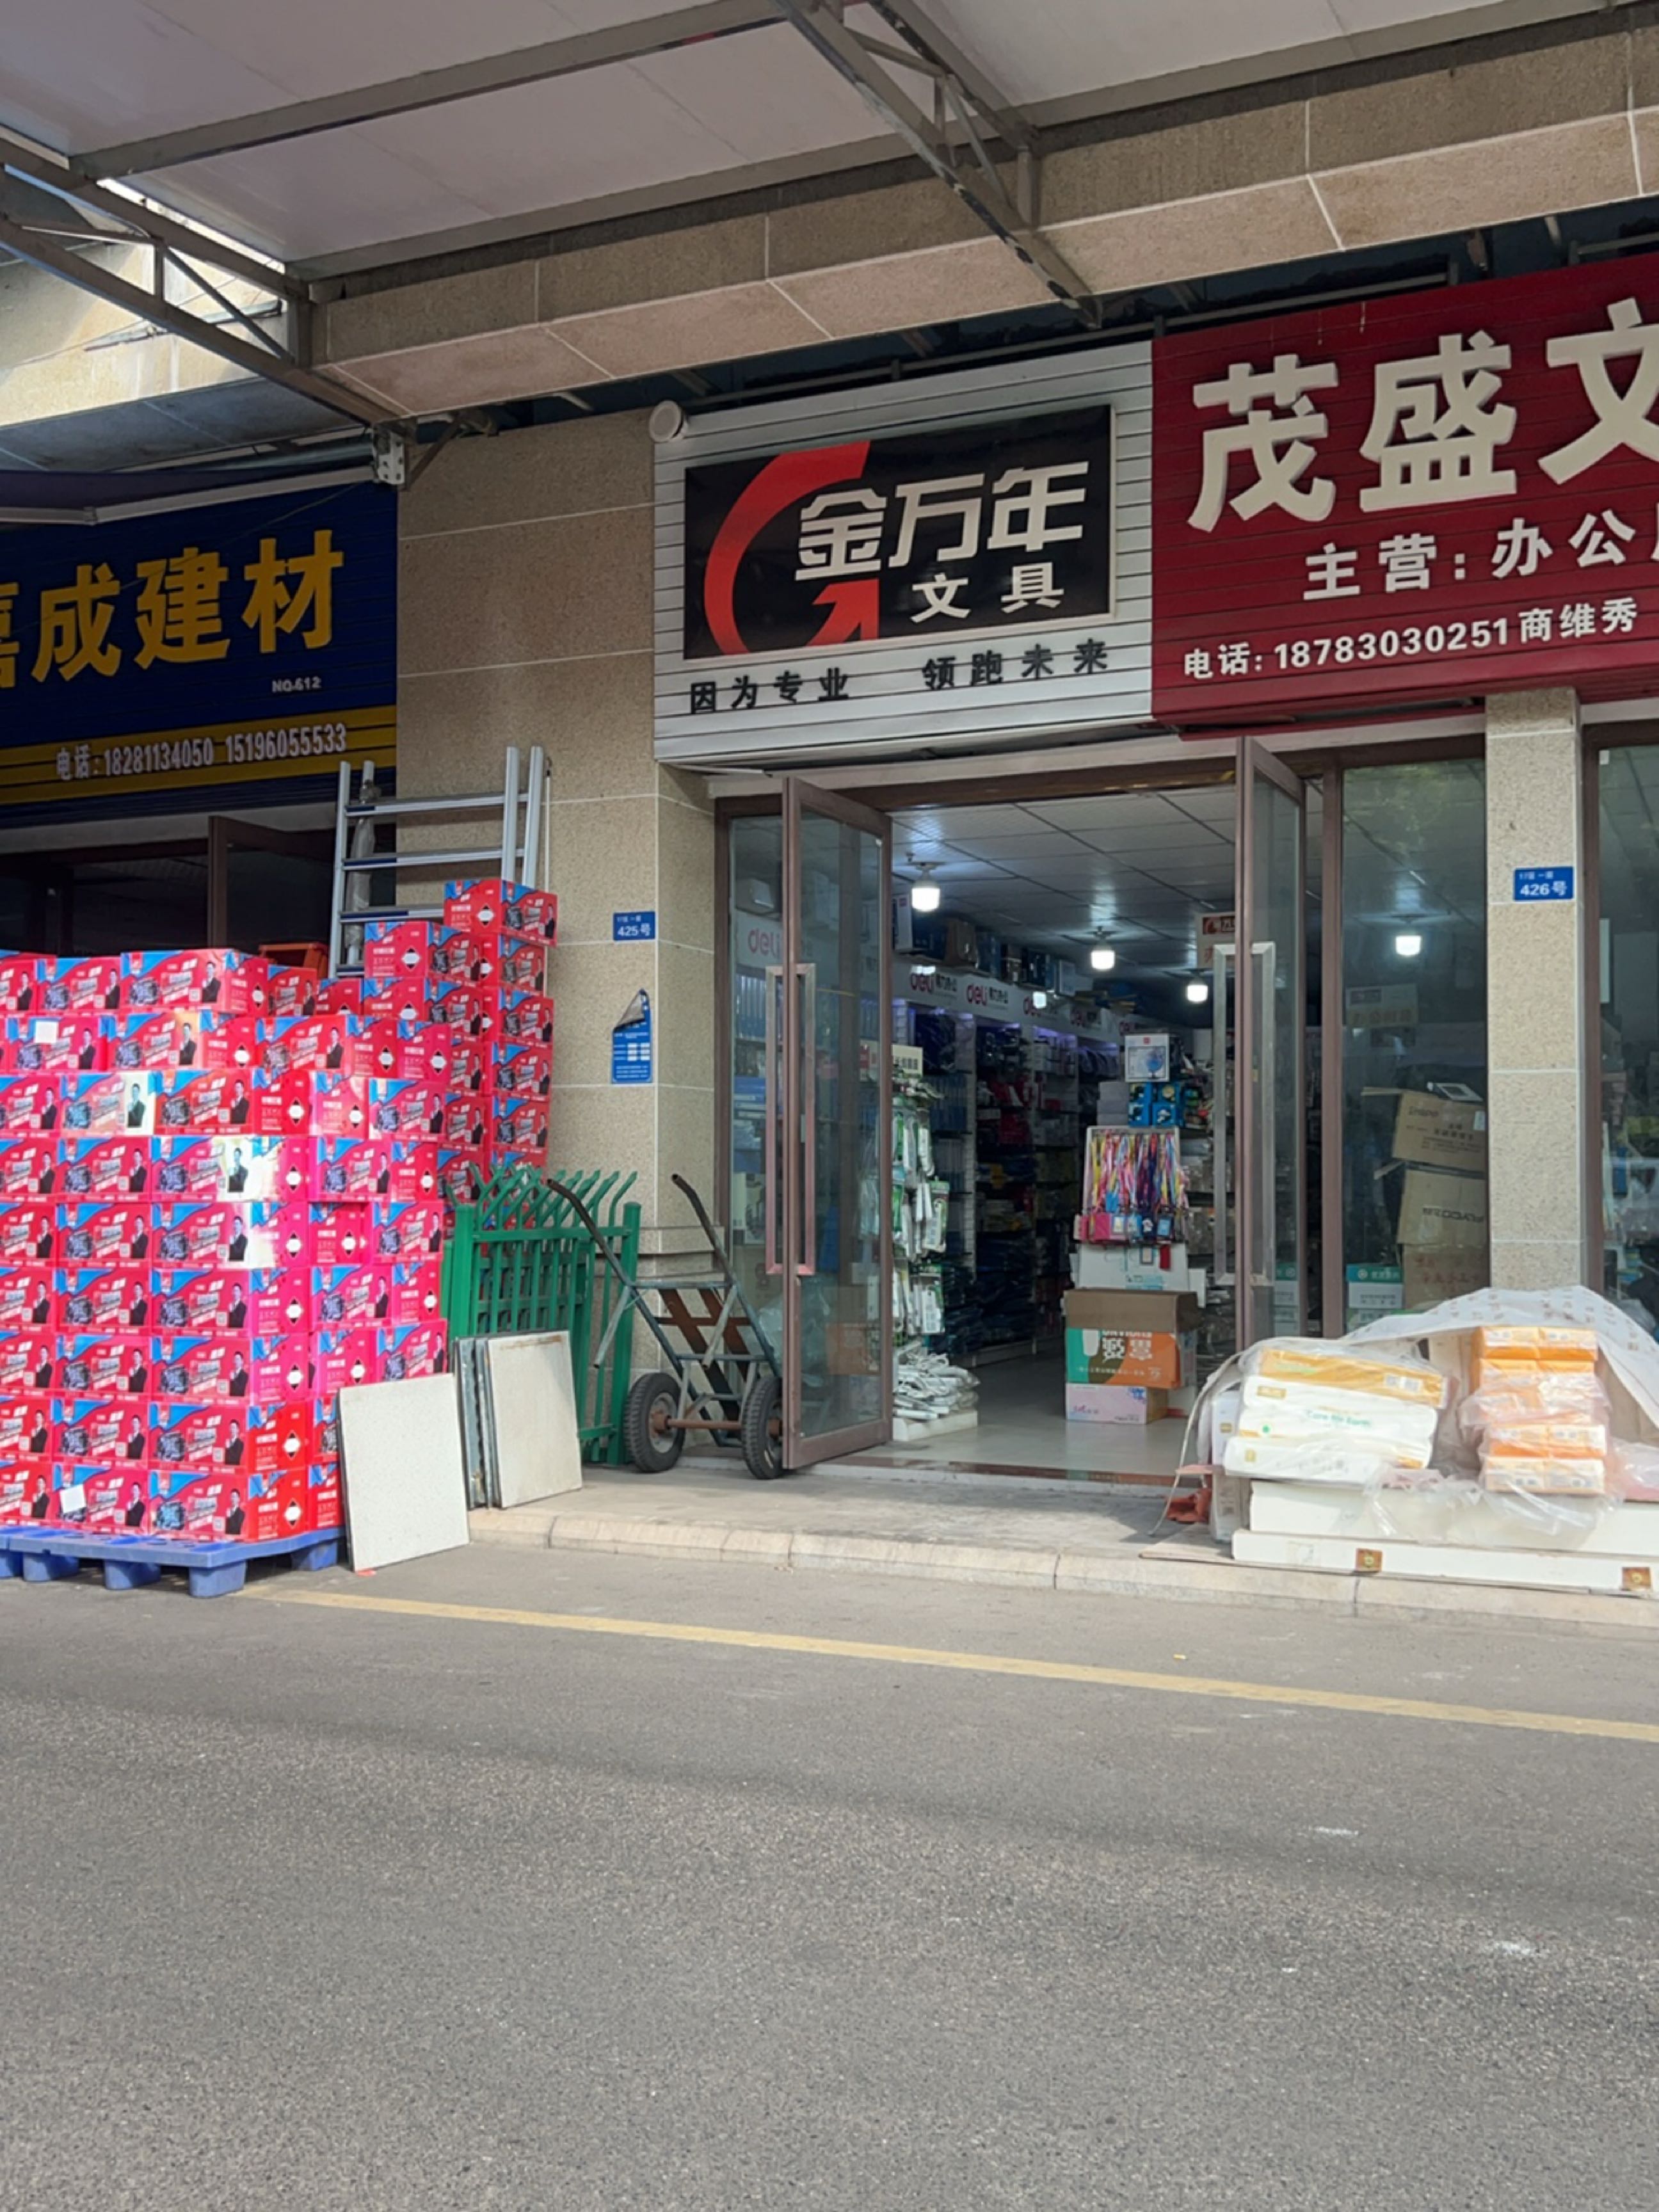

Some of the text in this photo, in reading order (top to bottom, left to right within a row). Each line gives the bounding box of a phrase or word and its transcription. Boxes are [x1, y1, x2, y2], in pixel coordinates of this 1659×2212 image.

[1187, 298, 1659, 533] 茂盛文
[795, 461, 1089, 581] 金万年
[1303, 502, 1659, 600] 主营：办公
[0, 529, 344, 689] 成建材
[911, 563, 1064, 623] 文具
[690, 638, 1109, 715] 因为专业 领跑未来
[225, 723, 346, 764] 15196055533
[1520, 881, 1567, 896] 426号
